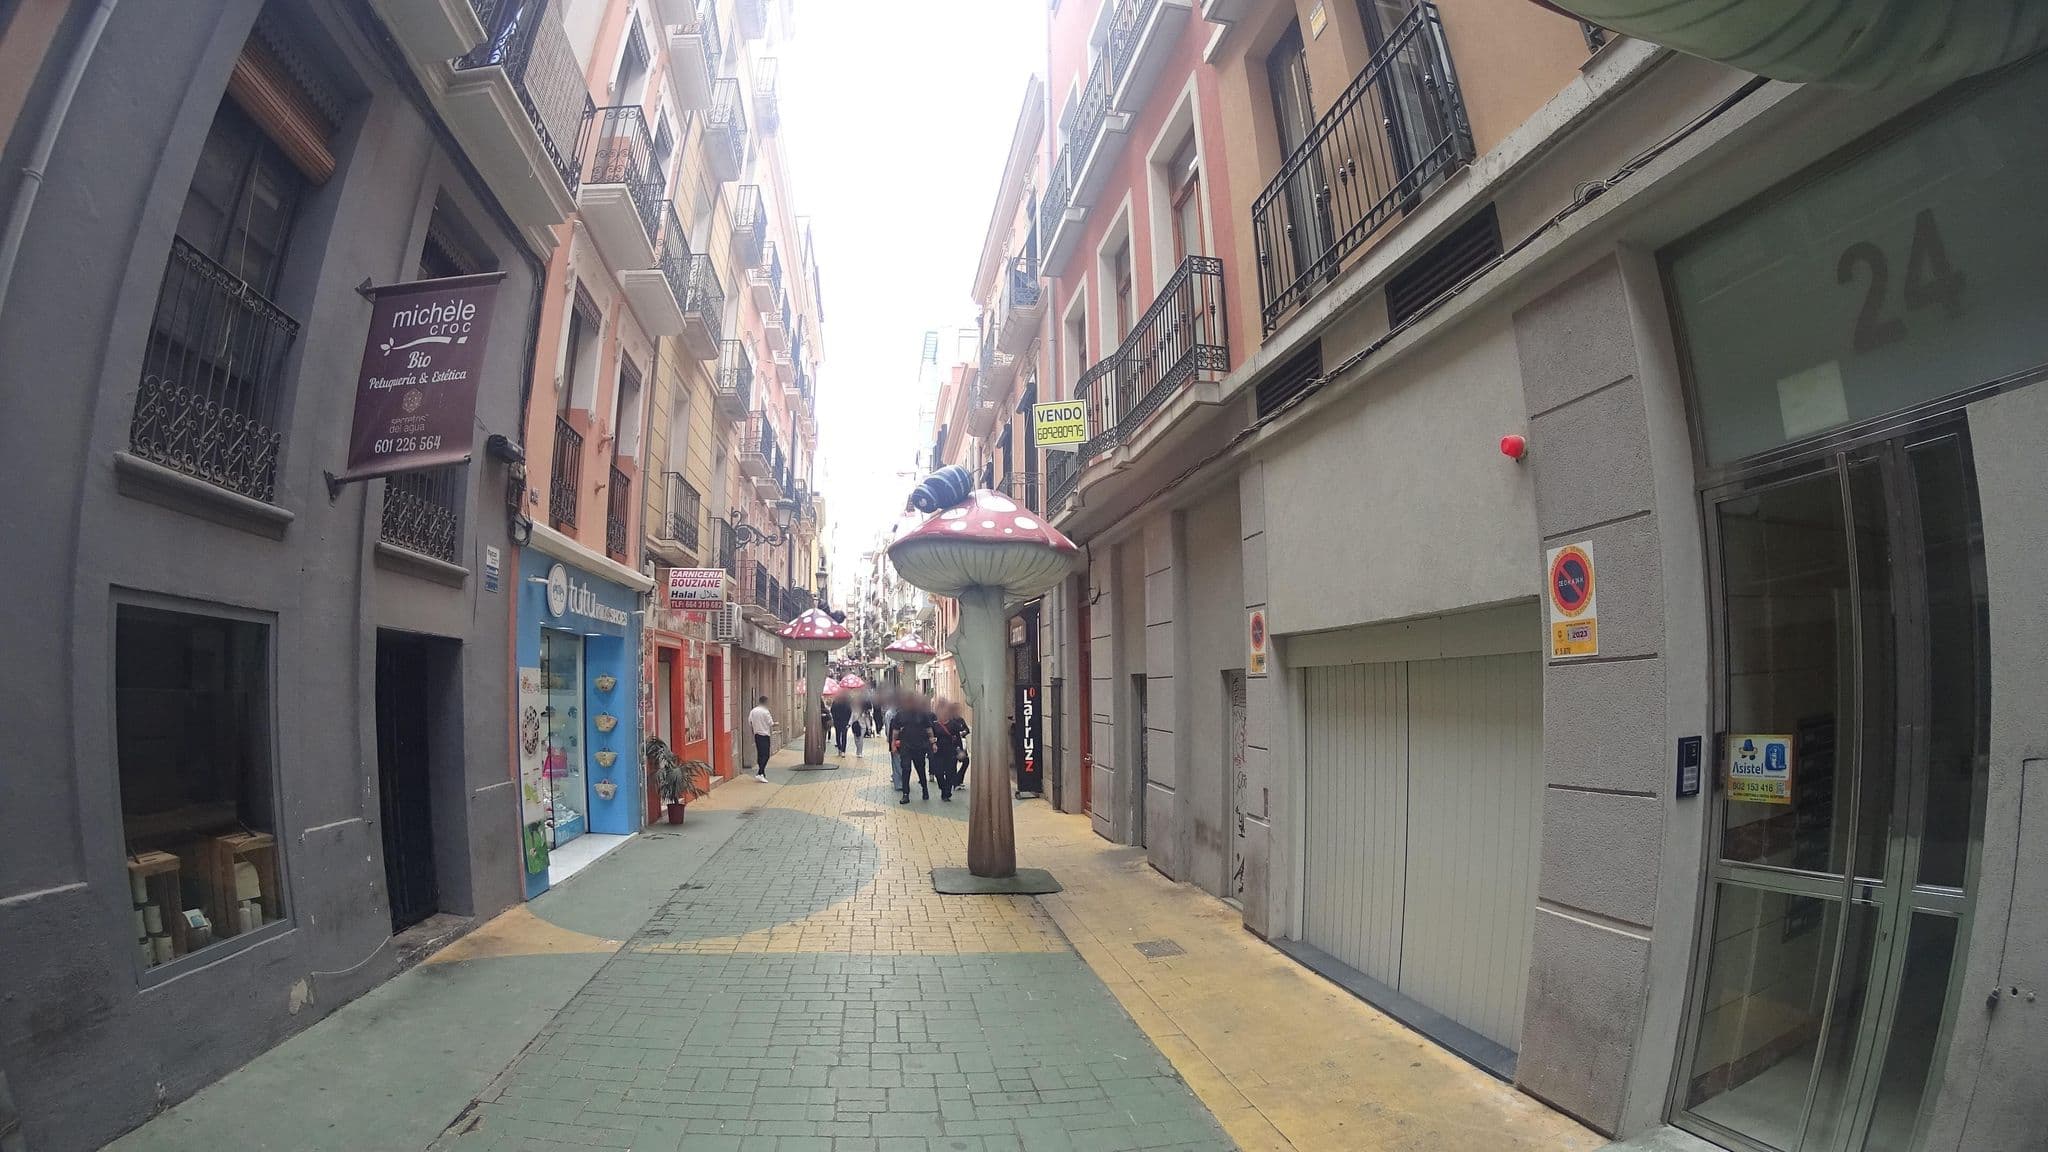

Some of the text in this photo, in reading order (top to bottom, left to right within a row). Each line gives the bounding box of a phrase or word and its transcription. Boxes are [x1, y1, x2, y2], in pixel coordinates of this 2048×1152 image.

[1837, 208, 1966, 354] 24
[392, 299, 476, 328] michèle
[430, 321, 472, 335] croc
[407, 351, 432, 369] Bio
[369, 369, 467, 392] Peluquería & Estética
[1037, 407, 1082, 422] VENDO
[403, 423, 425, 434] agua
[374, 434, 441, 454] 601 226 564
[671, 570, 723, 578] CARNICERIA
[671, 579, 721, 588] BOUZIANE
[568, 577, 596, 618] tutu
[671, 590, 697, 599] Halal
[1572, 630, 1588, 639] 2023
[1732, 762, 1764, 775] Asistel
